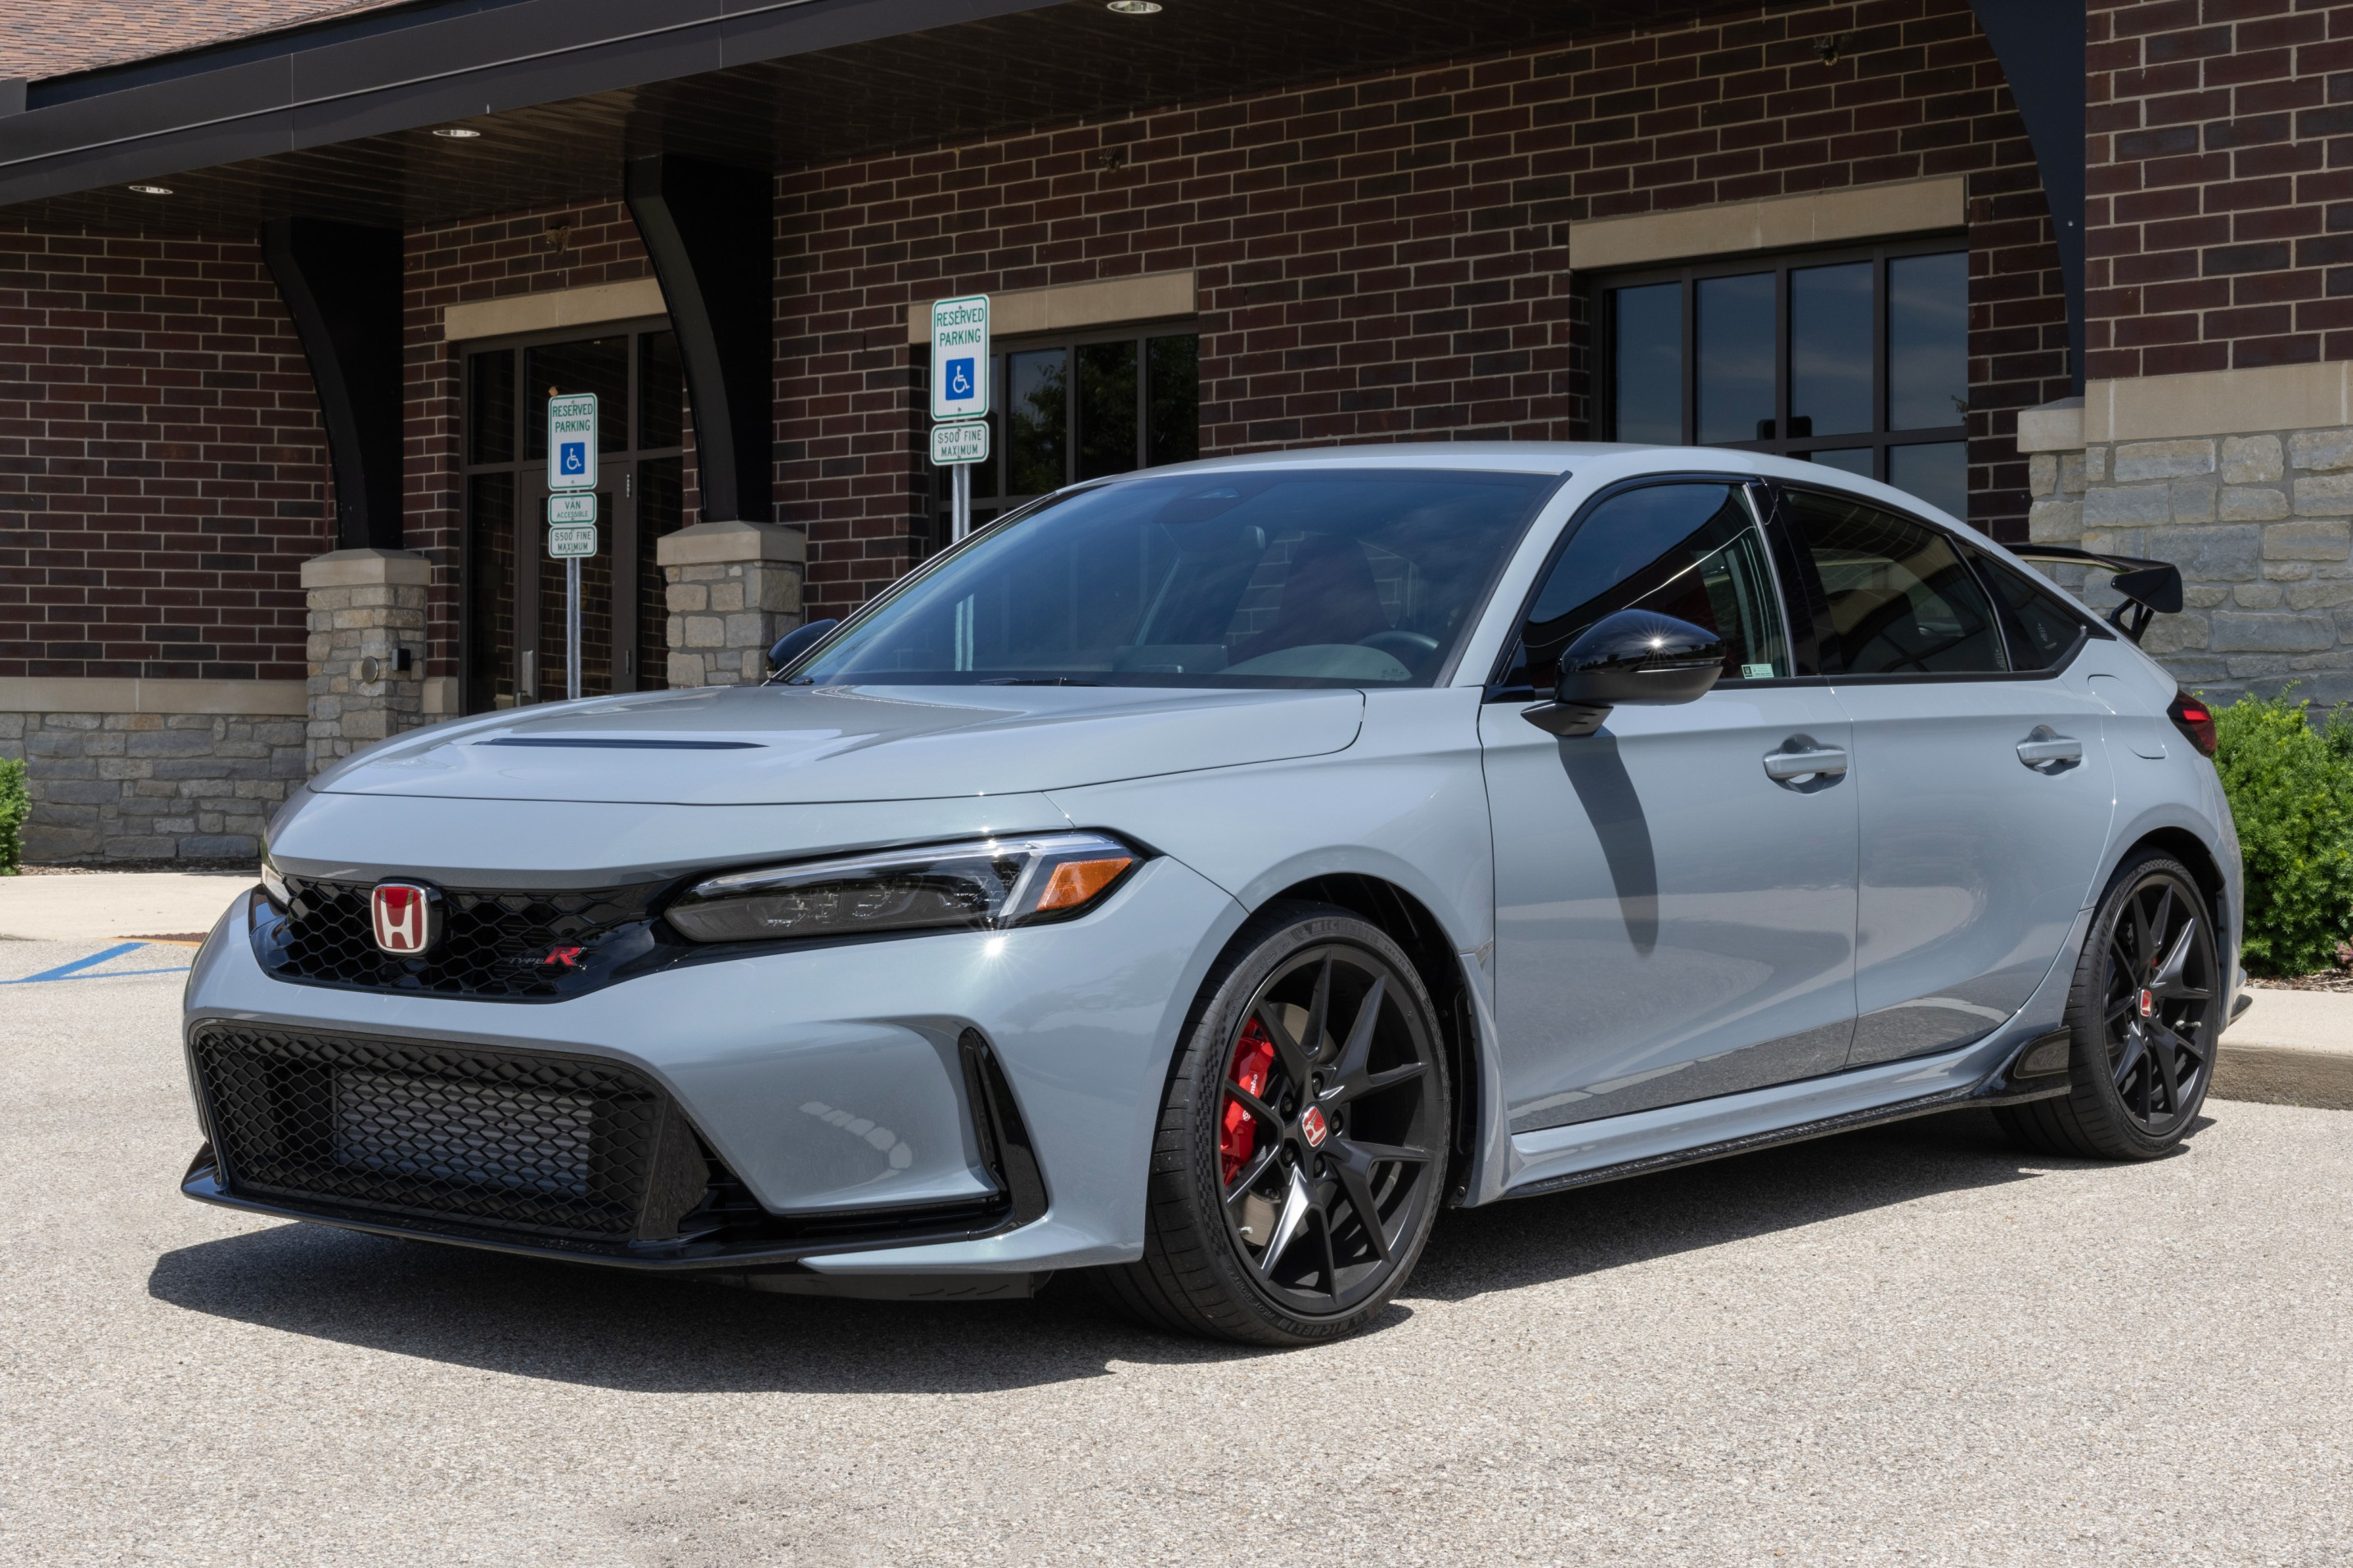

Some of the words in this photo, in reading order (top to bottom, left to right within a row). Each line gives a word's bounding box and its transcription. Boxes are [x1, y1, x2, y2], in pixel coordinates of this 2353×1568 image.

[936, 307, 984, 327] RESERVED
[940, 328, 981, 346] PARKING
[552, 403, 593, 417] RESERVED
[555, 419, 590, 432] PARKING
[937, 431, 959, 444] $500
[964, 429, 982, 441] FINE
[941, 443, 978, 457] MAXIMUM
[565, 501, 581, 510] VAN
[556, 510, 588, 519] ACCESSIBLE
[555, 532, 573, 542] $500
[576, 531, 592, 540] FINE
[557, 542, 588, 552] MAXIMUM
[1312, 920, 1380, 944] MICHELIN
[543, 946, 583, 967] R
[1254, 1301, 1275, 1319] PILOT
[1278, 1317, 1348, 1337] MICHELIN
